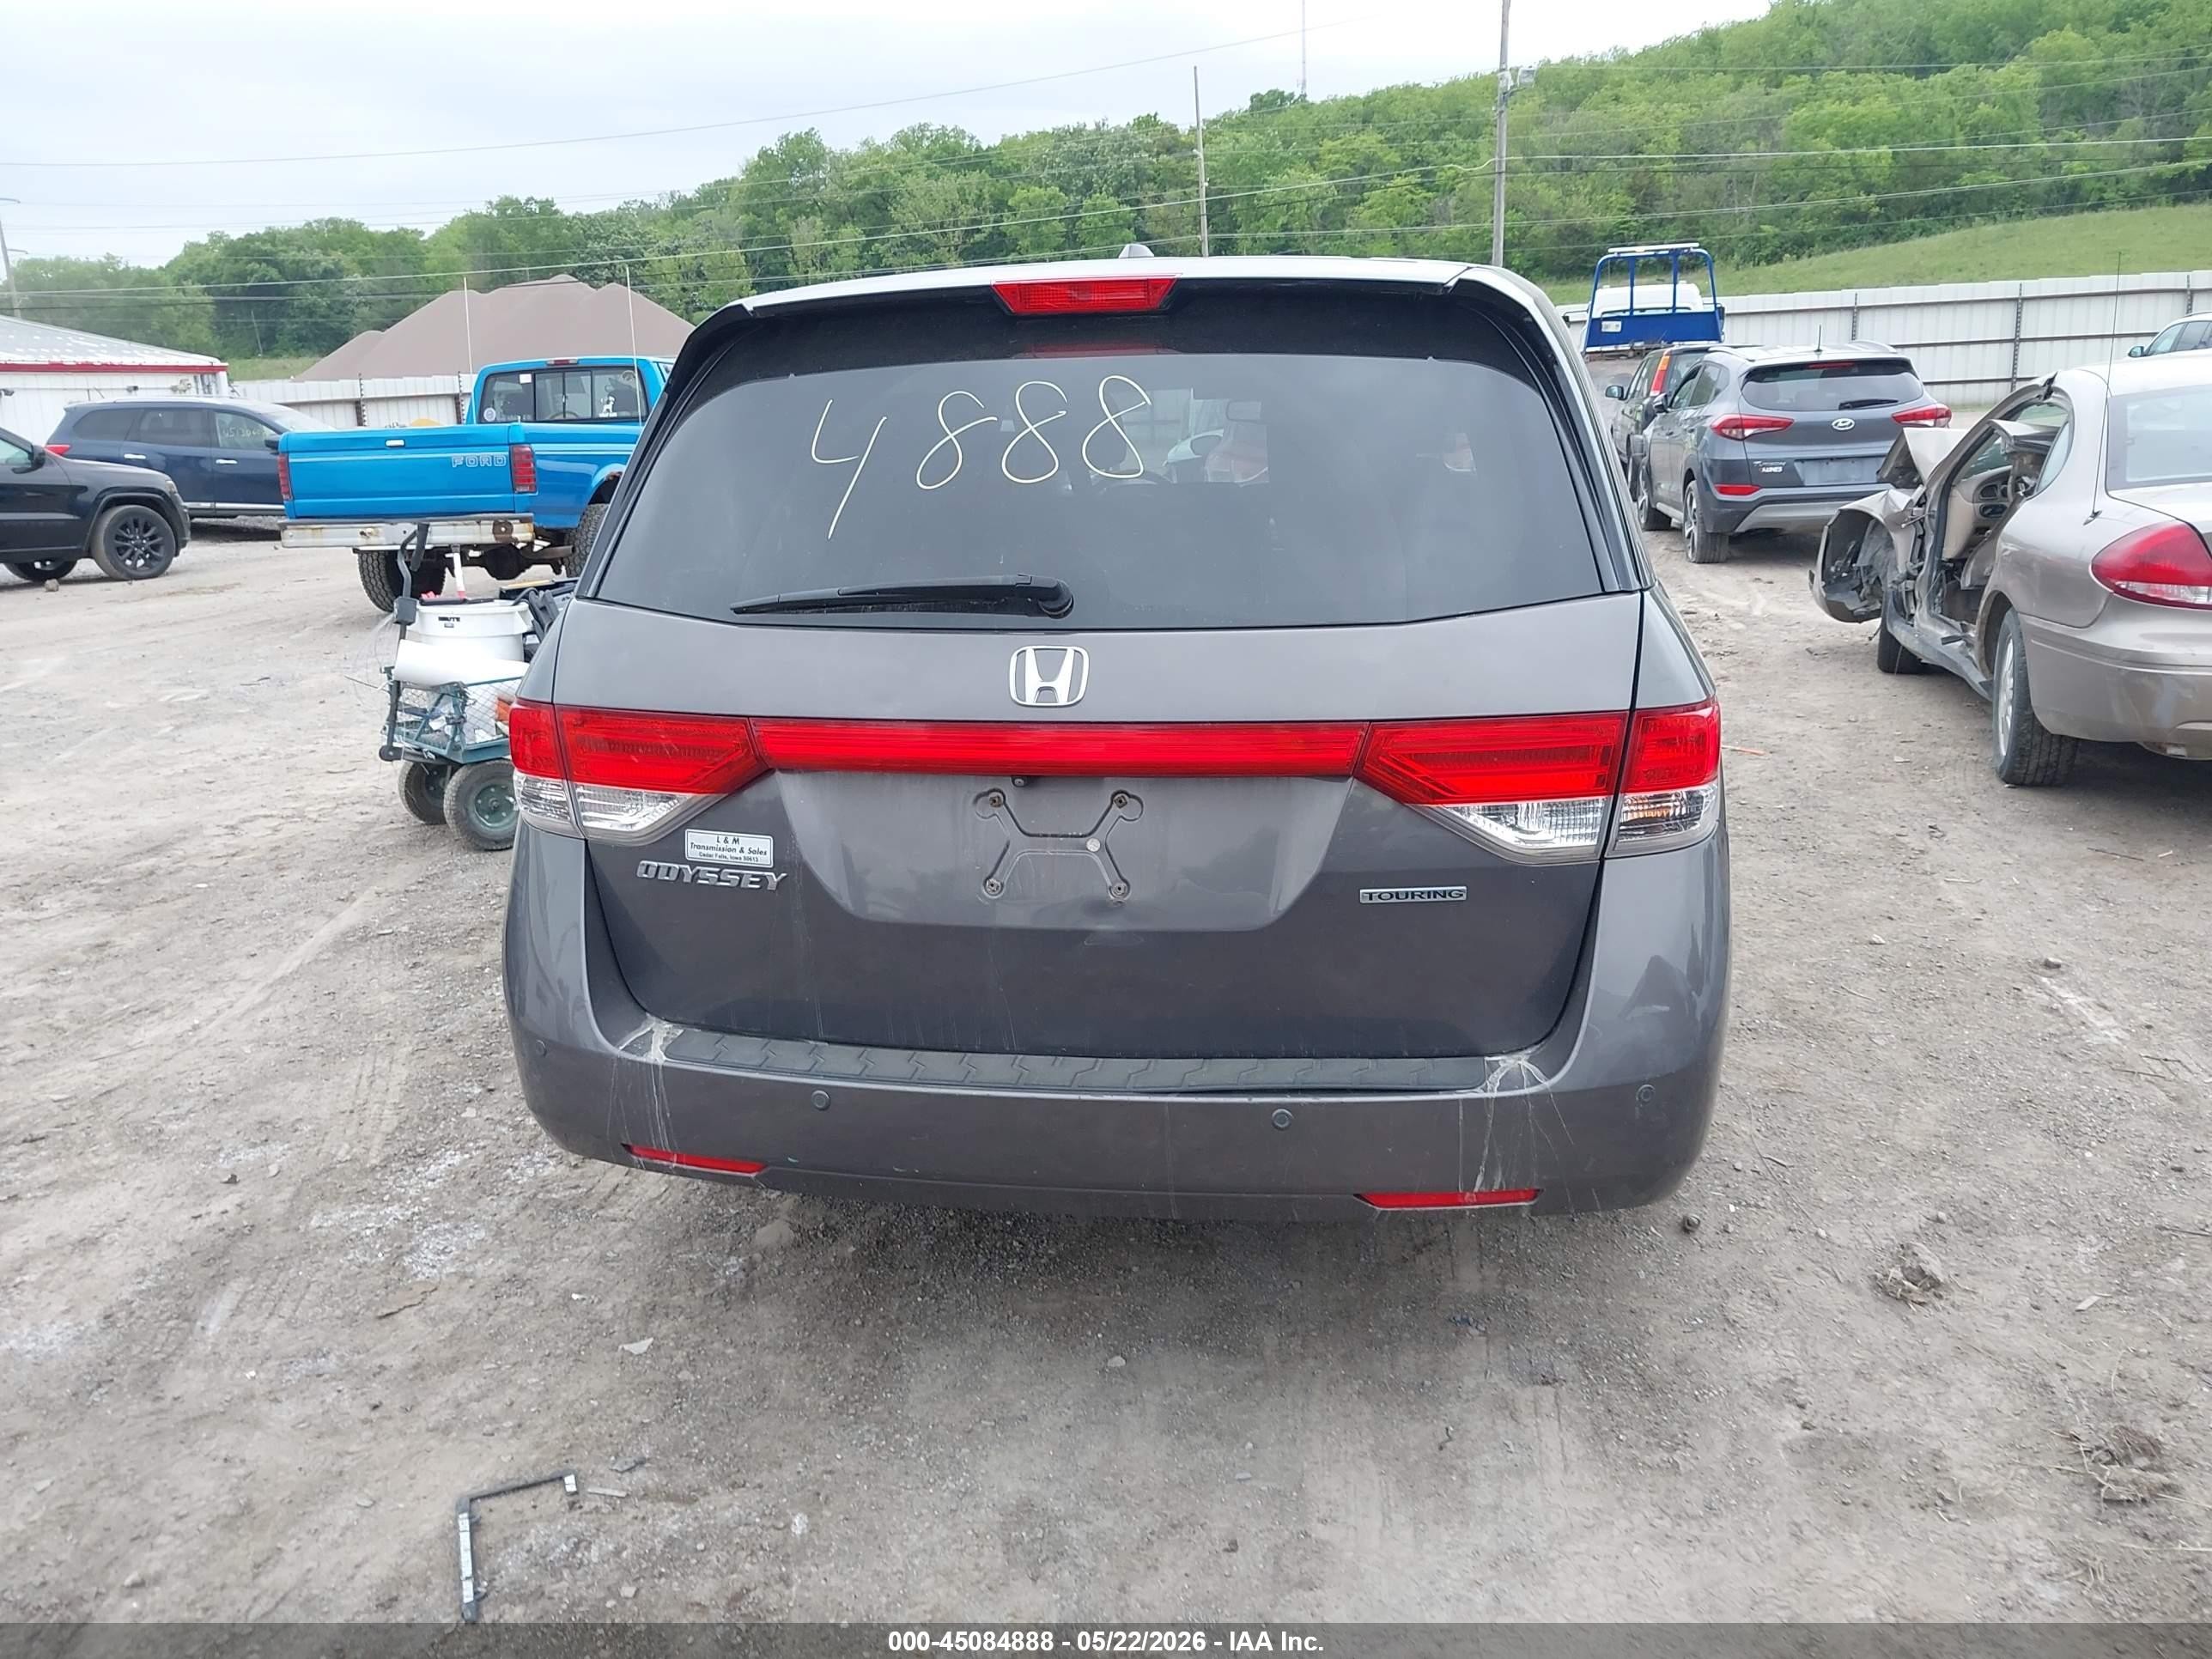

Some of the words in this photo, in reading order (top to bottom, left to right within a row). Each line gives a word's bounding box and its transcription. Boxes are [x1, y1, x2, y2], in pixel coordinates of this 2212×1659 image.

[452, 453, 507, 468] FORD
[811, 374, 1152, 541] 4888
[716, 836, 720, 844] L
[732, 836, 740, 845] M
[690, 842, 737, 854] Transmission
[738, 846, 745, 854] &
[747, 847, 768, 856] Sales
[636, 860, 787, 890] ODYSSEY
[1363, 889, 1465, 902] TOURING
